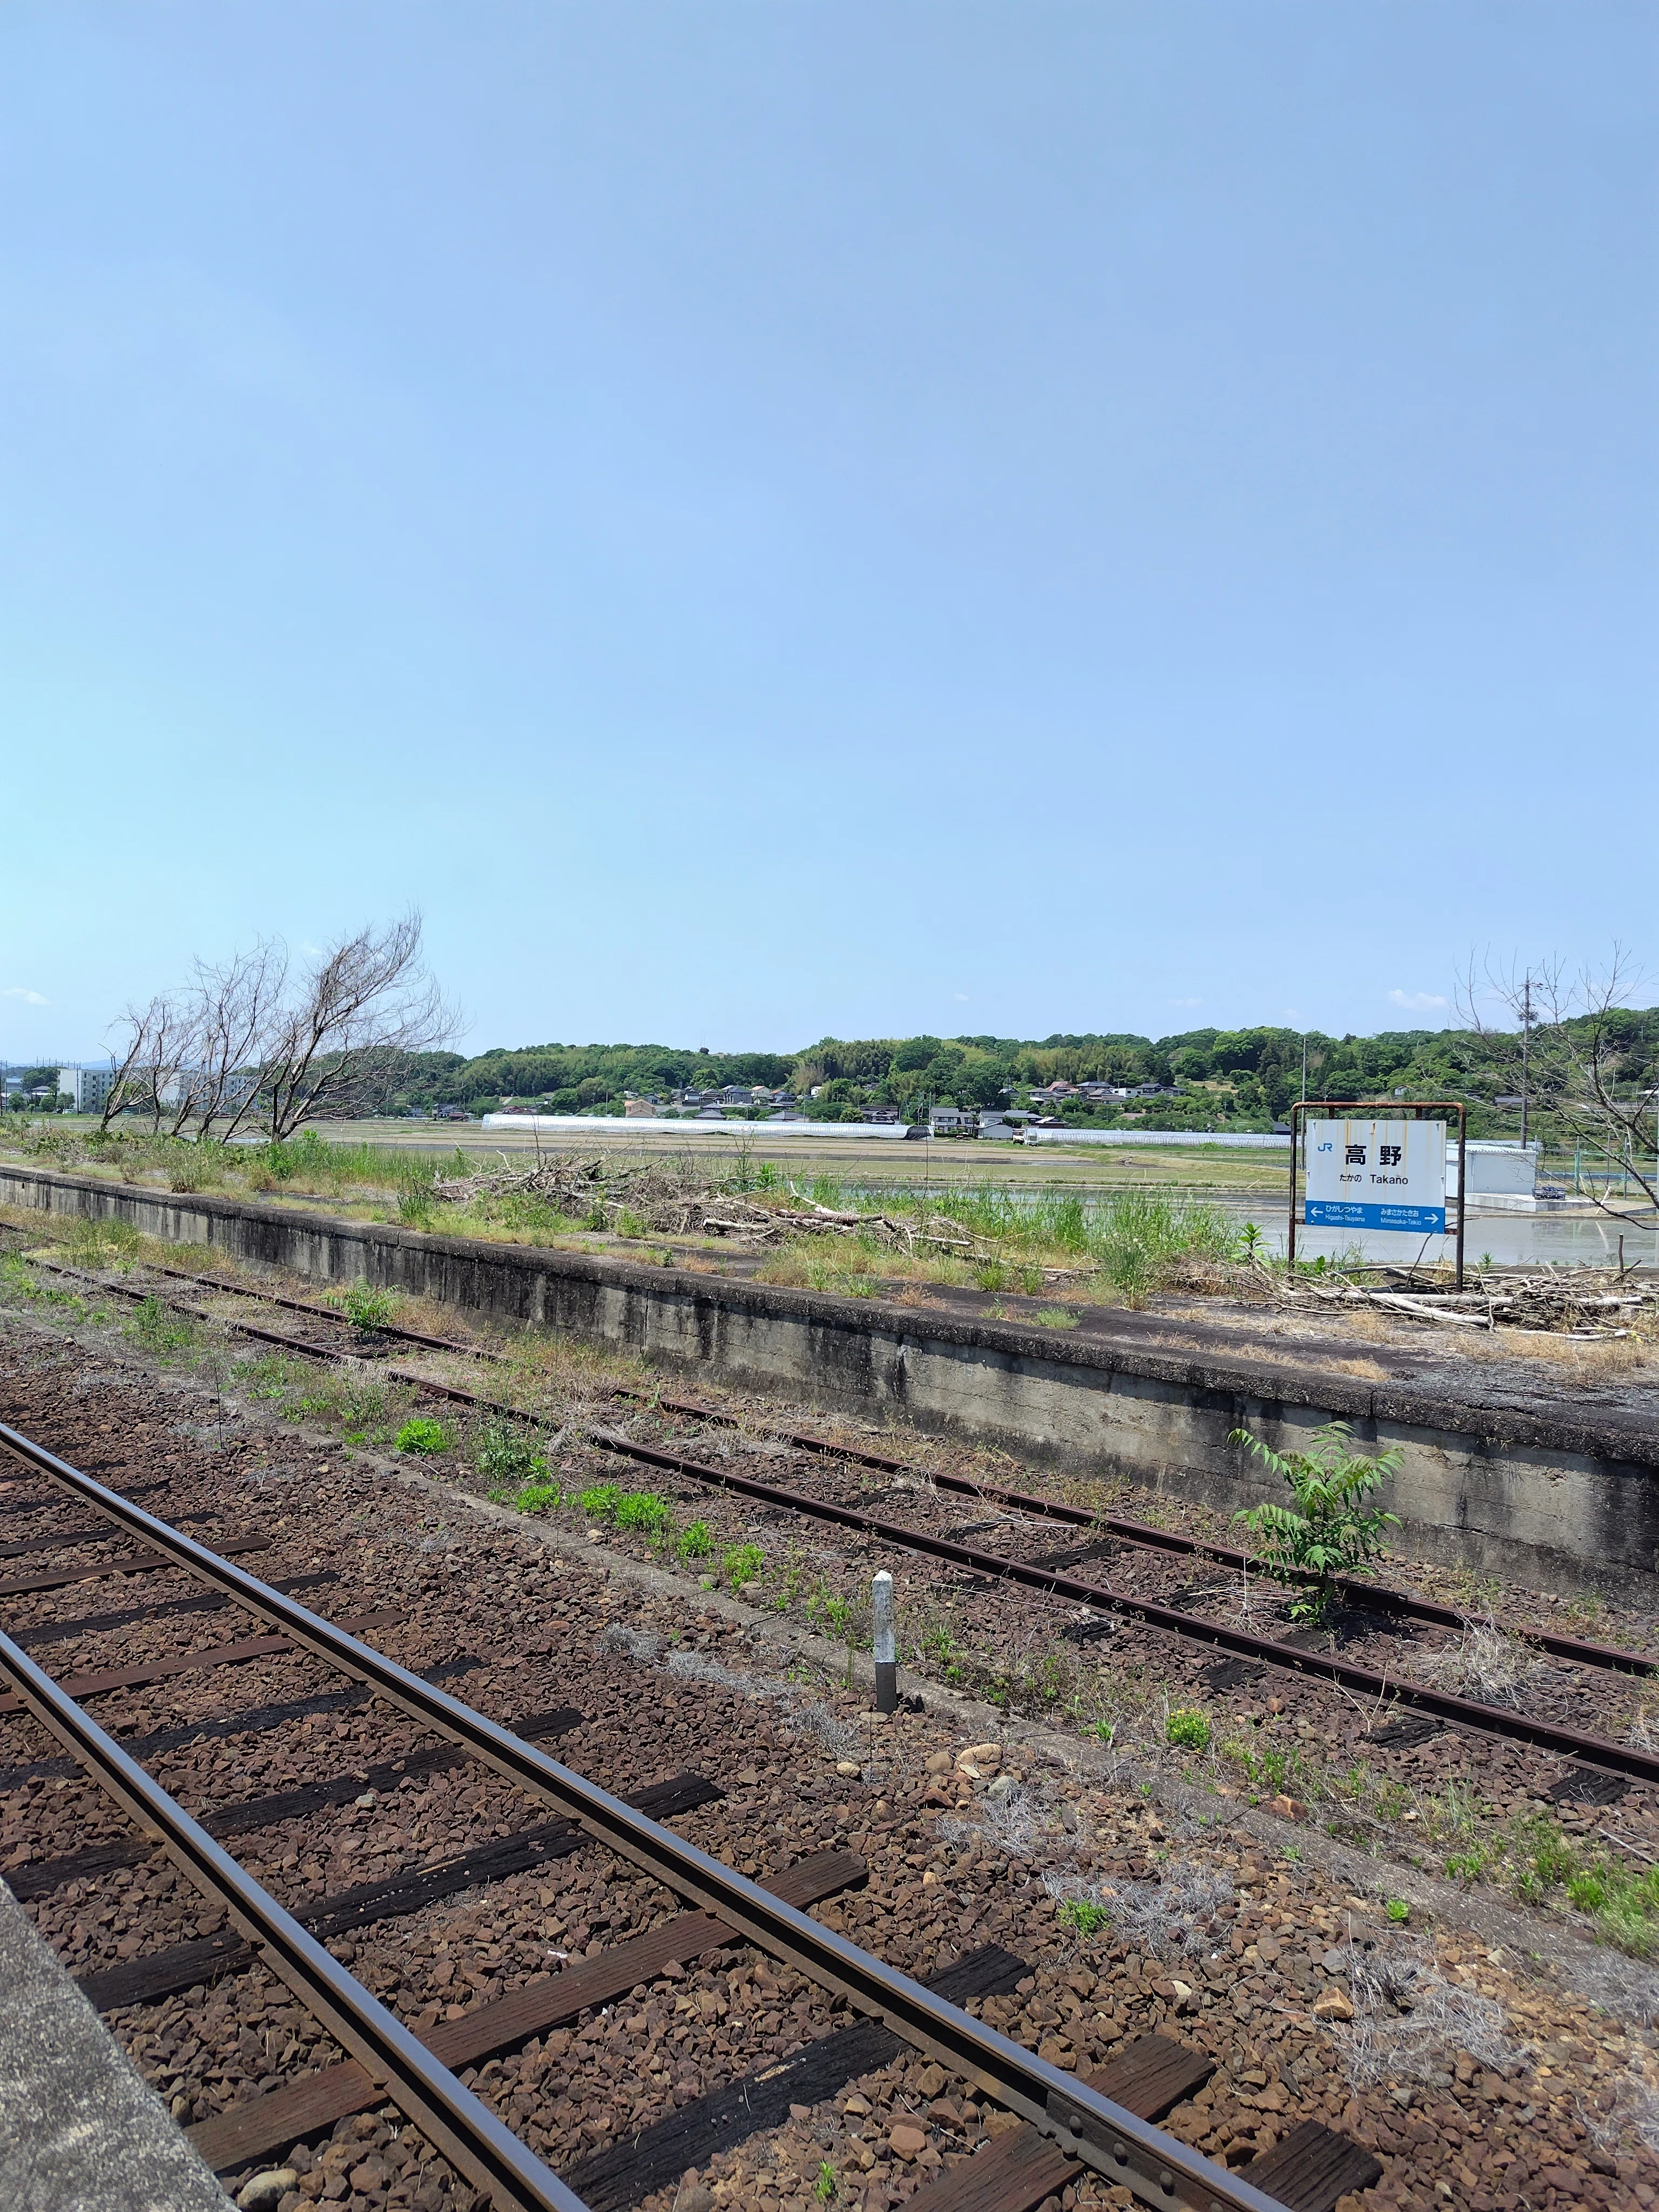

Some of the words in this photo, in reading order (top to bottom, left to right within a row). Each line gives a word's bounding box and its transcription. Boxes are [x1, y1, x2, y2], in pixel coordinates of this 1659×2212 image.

[1318, 1143, 1332, 1152] JR
[1345, 1144, 1401, 1166] 高野
[1339, 1174, 1362, 1183] たかの
[1370, 1174, 1408, 1184] Takano
[1325, 1205, 1364, 1214] ひがしつやま
[1380, 1208, 1419, 1217] みまさかたきお
[1325, 1214, 1365, 1223] Higashi-Tsuyama
[1380, 1218, 1421, 1226] Mimasaka-Takio
